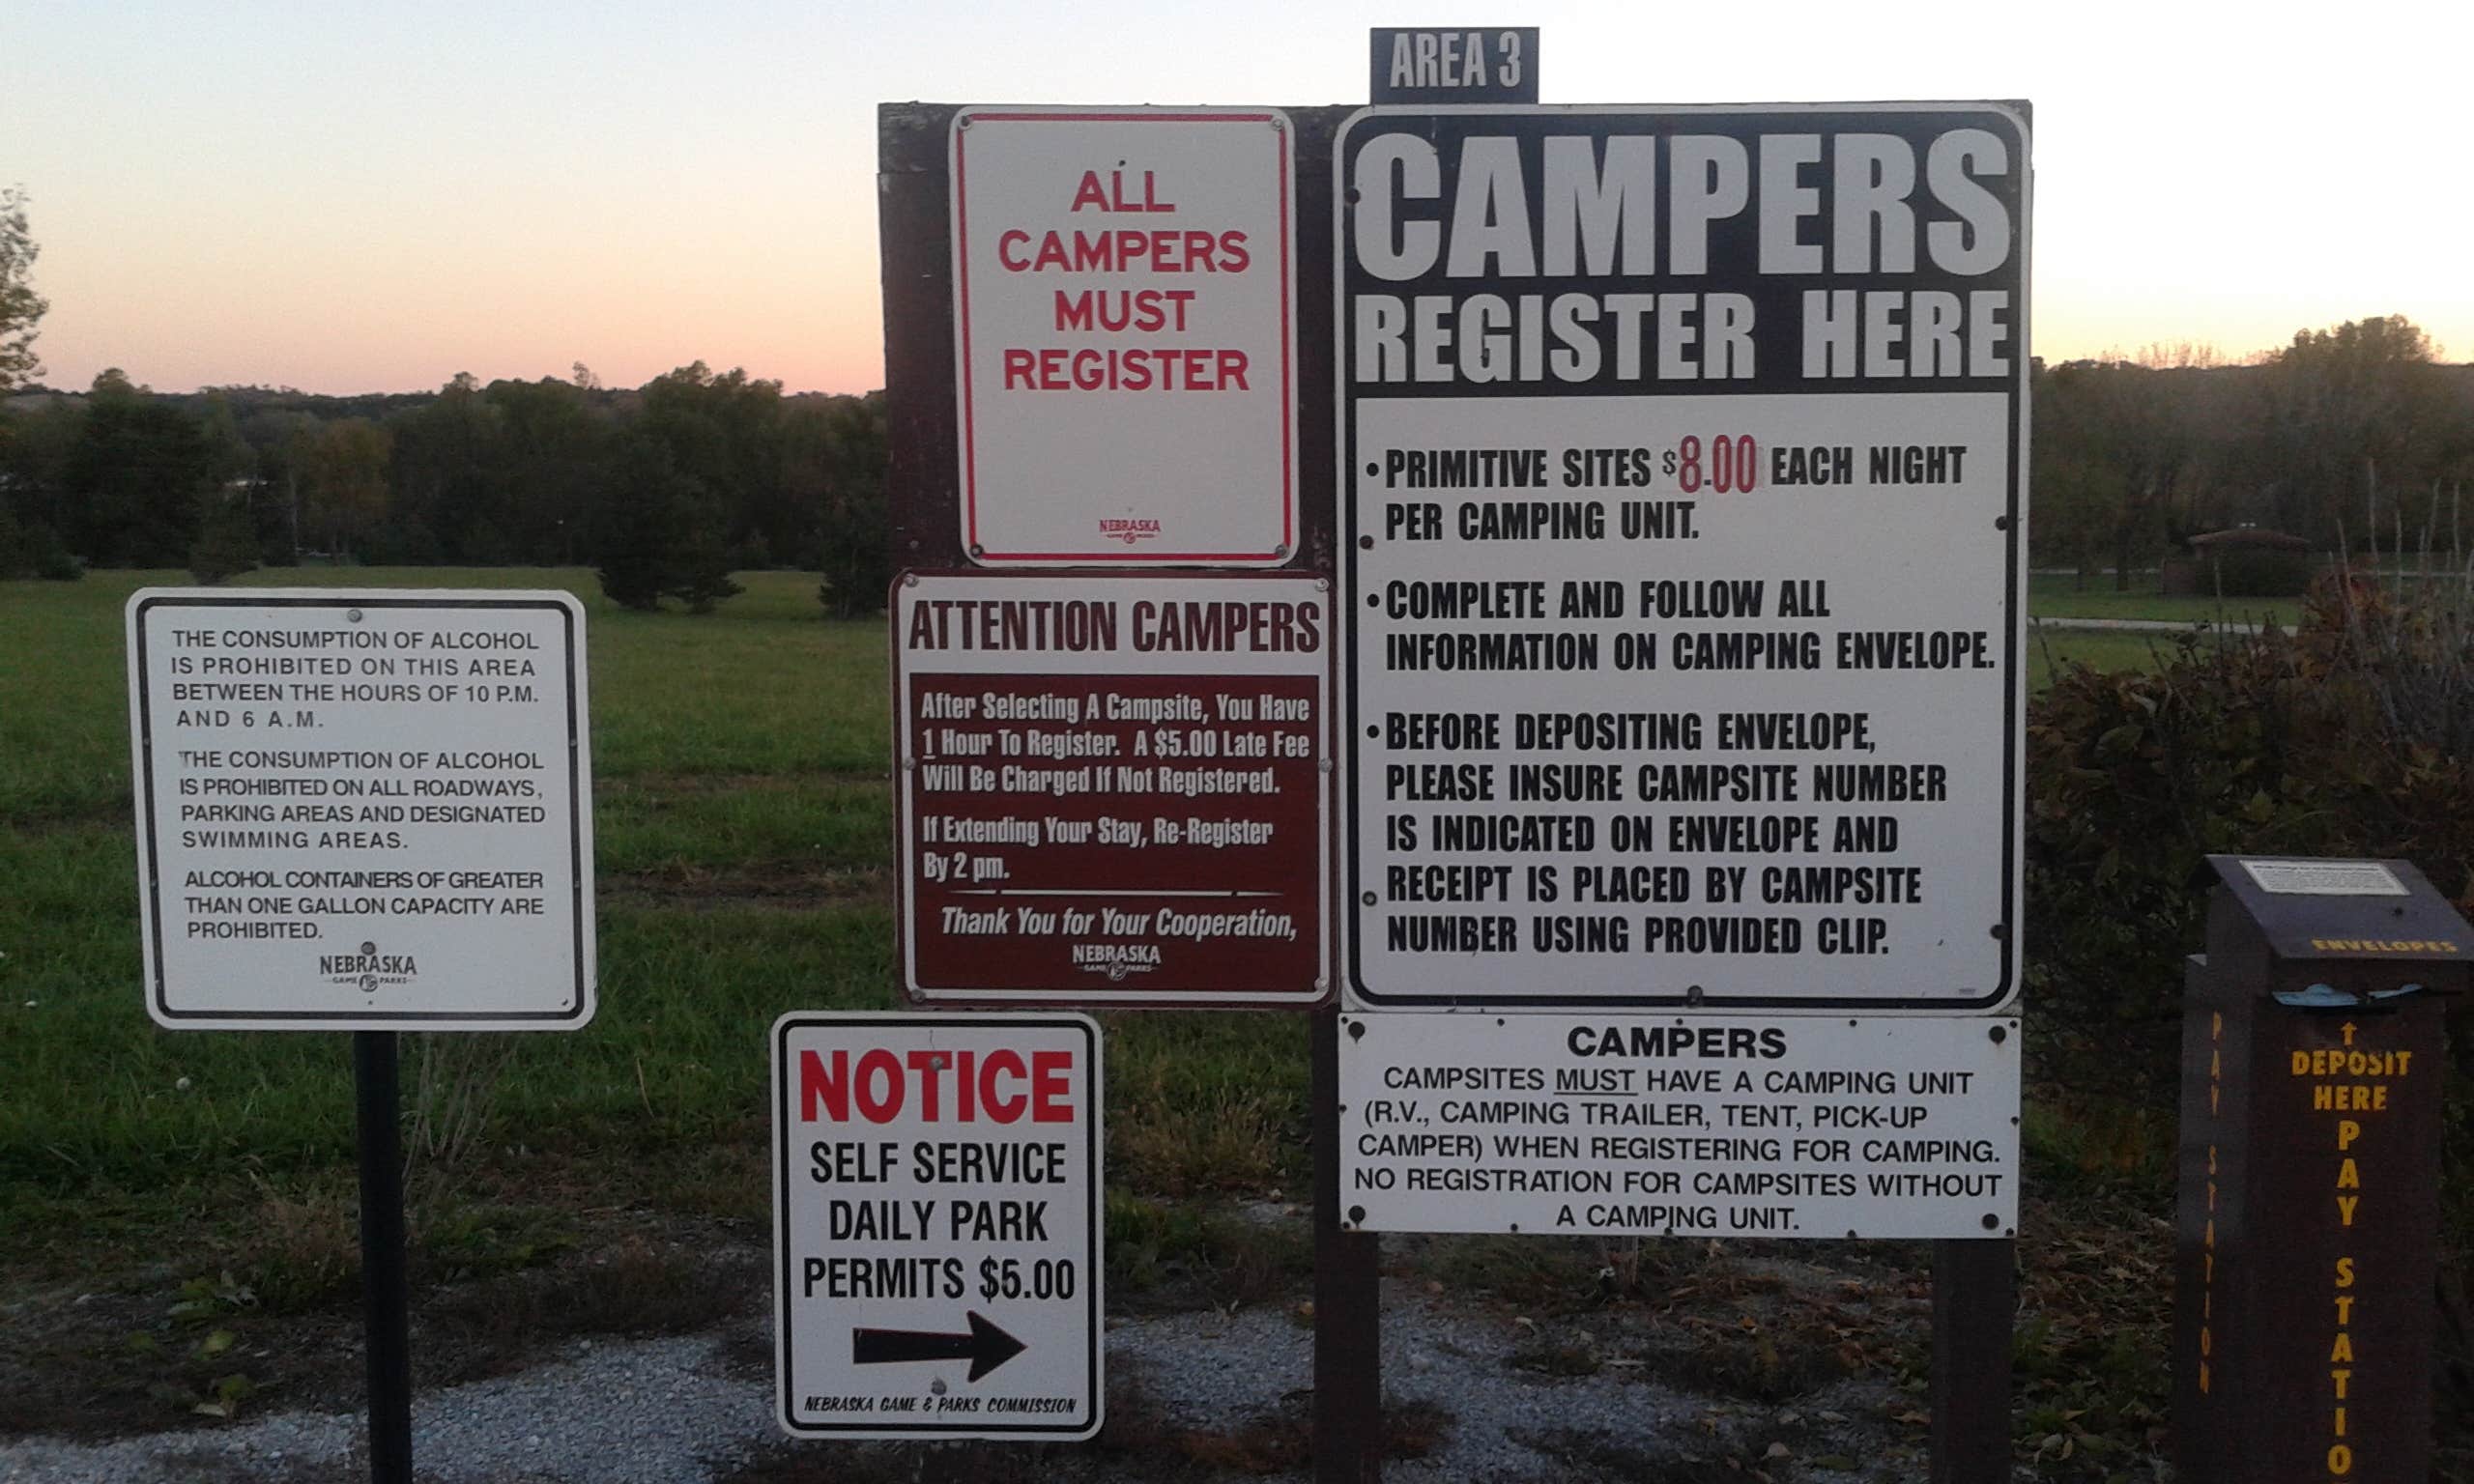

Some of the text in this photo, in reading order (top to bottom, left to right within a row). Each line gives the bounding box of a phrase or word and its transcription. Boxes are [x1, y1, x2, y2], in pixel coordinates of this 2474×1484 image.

[1391, 31, 1520, 87] AREA 3
[1072, 171, 1175, 213] ALL
[1354, 128, 2011, 280] CAMPERS
[1000, 231, 1249, 271] CAMPERS
[1055, 291, 1194, 331] MUST
[1356, 290, 2009, 383] REGISTER HERE
[1005, 350, 1249, 390] REGISTER
[1387, 449, 1547, 488] PRIMITIVE
[1564, 448, 1651, 487] SITES
[1772, 446, 1852, 485] EACH
[1870, 446, 1967, 484] NIGHT
[1100, 519, 1161, 532] NEBRASKA
[1387, 501, 1698, 540] PER CAMPING UNIT.
[1387, 580, 1829, 619] COMPLETE AND FOLLOW ALL
[172, 630, 539, 649] THE CONSUMPTION OF ALCOHOL
[909, 600, 1319, 652] ATTENTION CAMPERS
[172, 657, 534, 676] IS PROHIBITED ON THIS AREA
[1387, 631, 1995, 671] INFORMATION ON CAMPING ENVELOPE.
[174, 684, 538, 702] BETWEEN THE HOURS OF 10 P.M.
[921, 693, 1309, 724] After Selecting A Campsite, You Have
[177, 710, 323, 727] AND 6 A.M.
[1387, 712, 1875, 753] BEFORE DEPOSITING ENVELOPE,
[923, 728, 1309, 759] 1 Hour To Register. A $5.00 Late Fee
[923, 765, 1280, 796] Will Be Charged If Not Registered.
[1387, 764, 1945, 802] PLEASE INSURE CAMPSITE NUMBER
[182, 805, 545, 822] PARKING AREAS AND DESIGNATED
[183, 831, 407, 848] SWIMMING AREAS.
[924, 816, 1273, 847] If Extending Your Stay, Re-Register
[924, 852, 1009, 882] By 2 pm.
[1388, 866, 1920, 903] RECEIPT IS PLACED BY CAMPSITE
[185, 898, 544, 914] THAN ONE GALLON CAPACITY ARE
[188, 922, 322, 938] PROHIBITED.
[942, 907, 1296, 942] Thank You for Your Cooperation,
[1388, 916, 1888, 955] NUMBER USING PROVIDED CLIP.
[1073, 945, 1161, 963] NEBRASKA
[2311, 939, 2459, 953] ENVELOPES
[320, 956, 417, 975] NEBRASKA
[1568, 1027, 1786, 1059] CAMPERS
[2292, 1050, 2411, 1075] DEPOSIT
[801, 1049, 1073, 1124] NOTICE
[1385, 1067, 1973, 1096] CAMPSITES MUST HAVE A CAMPING UNIT
[2315, 1086, 2386, 1110] HERE
[1441, 1101, 1568, 1124] CAMPING
[1581, 1103, 1710, 1130] TRAILER,
[1721, 1104, 1801, 1131] TENT,
[1815, 1105, 1927, 1128] PICK-UP
[811, 1141, 1065, 1184] SELF SERVICE
[1359, 1134, 1999, 1162] CAMPER) WHEN REGISTERING FOR CAMPING.
[2337, 1120, 2360, 1225] PAY
[830, 1200, 1048, 1241] DAILY PARK
[1557, 1205, 1798, 1229] A CAMPING UNIT.
[804, 1255, 1074, 1303] PERMITS $5.00
[2327, 1258, 2354, 1484] STATIO
[804, 1396, 1077, 1413] NEBRASKA GAME & PARKS COMMISSION
